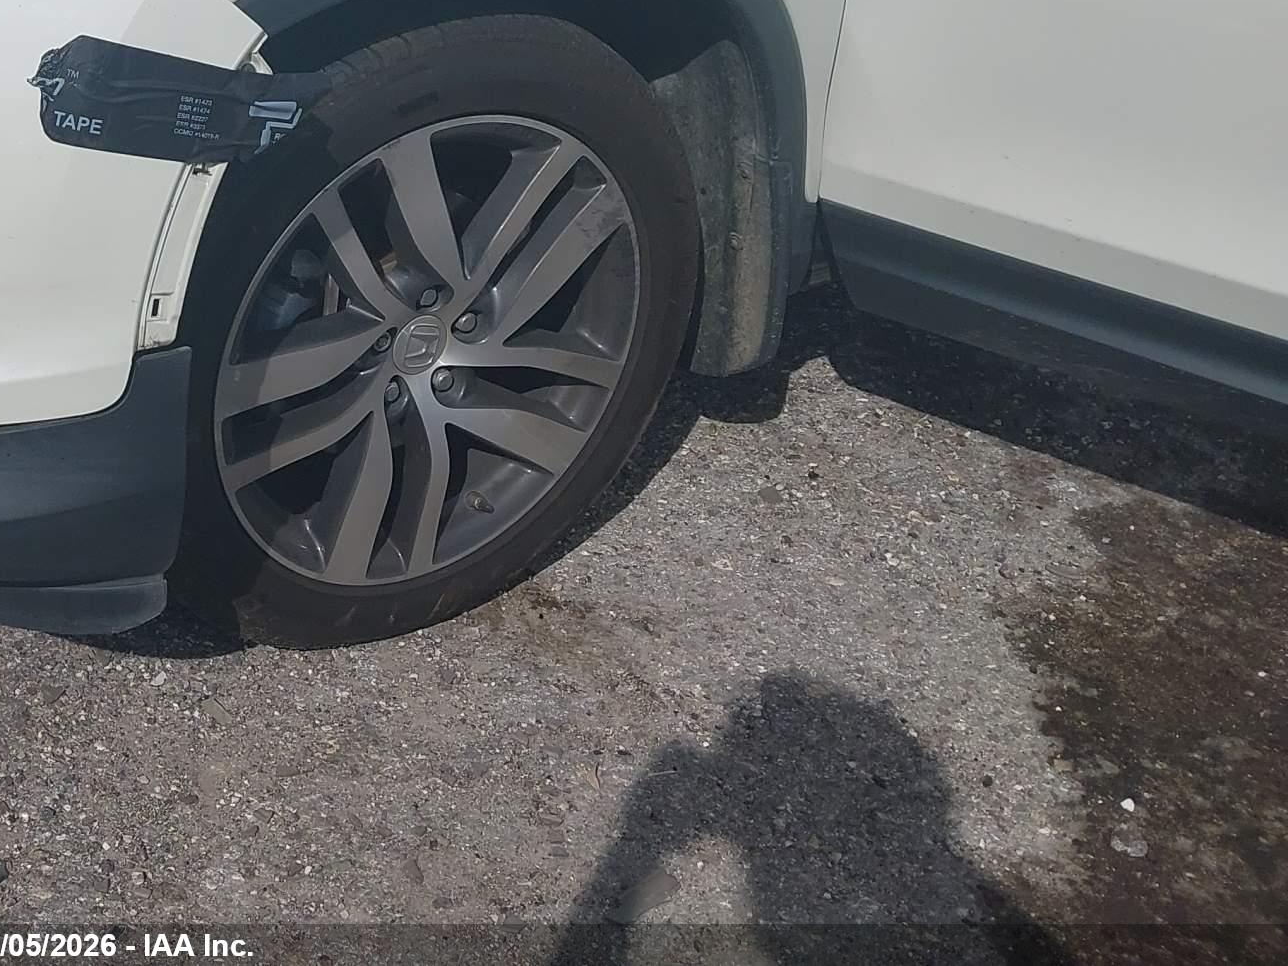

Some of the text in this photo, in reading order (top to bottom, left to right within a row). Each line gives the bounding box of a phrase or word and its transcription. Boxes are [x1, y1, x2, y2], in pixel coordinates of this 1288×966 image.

[66, 68, 80, 79] TM
[181, 95, 194, 104] ESR
[179, 104, 192, 112] ESR
[177, 112, 190, 120] ESR
[53, 110, 104, 135] TAPE
